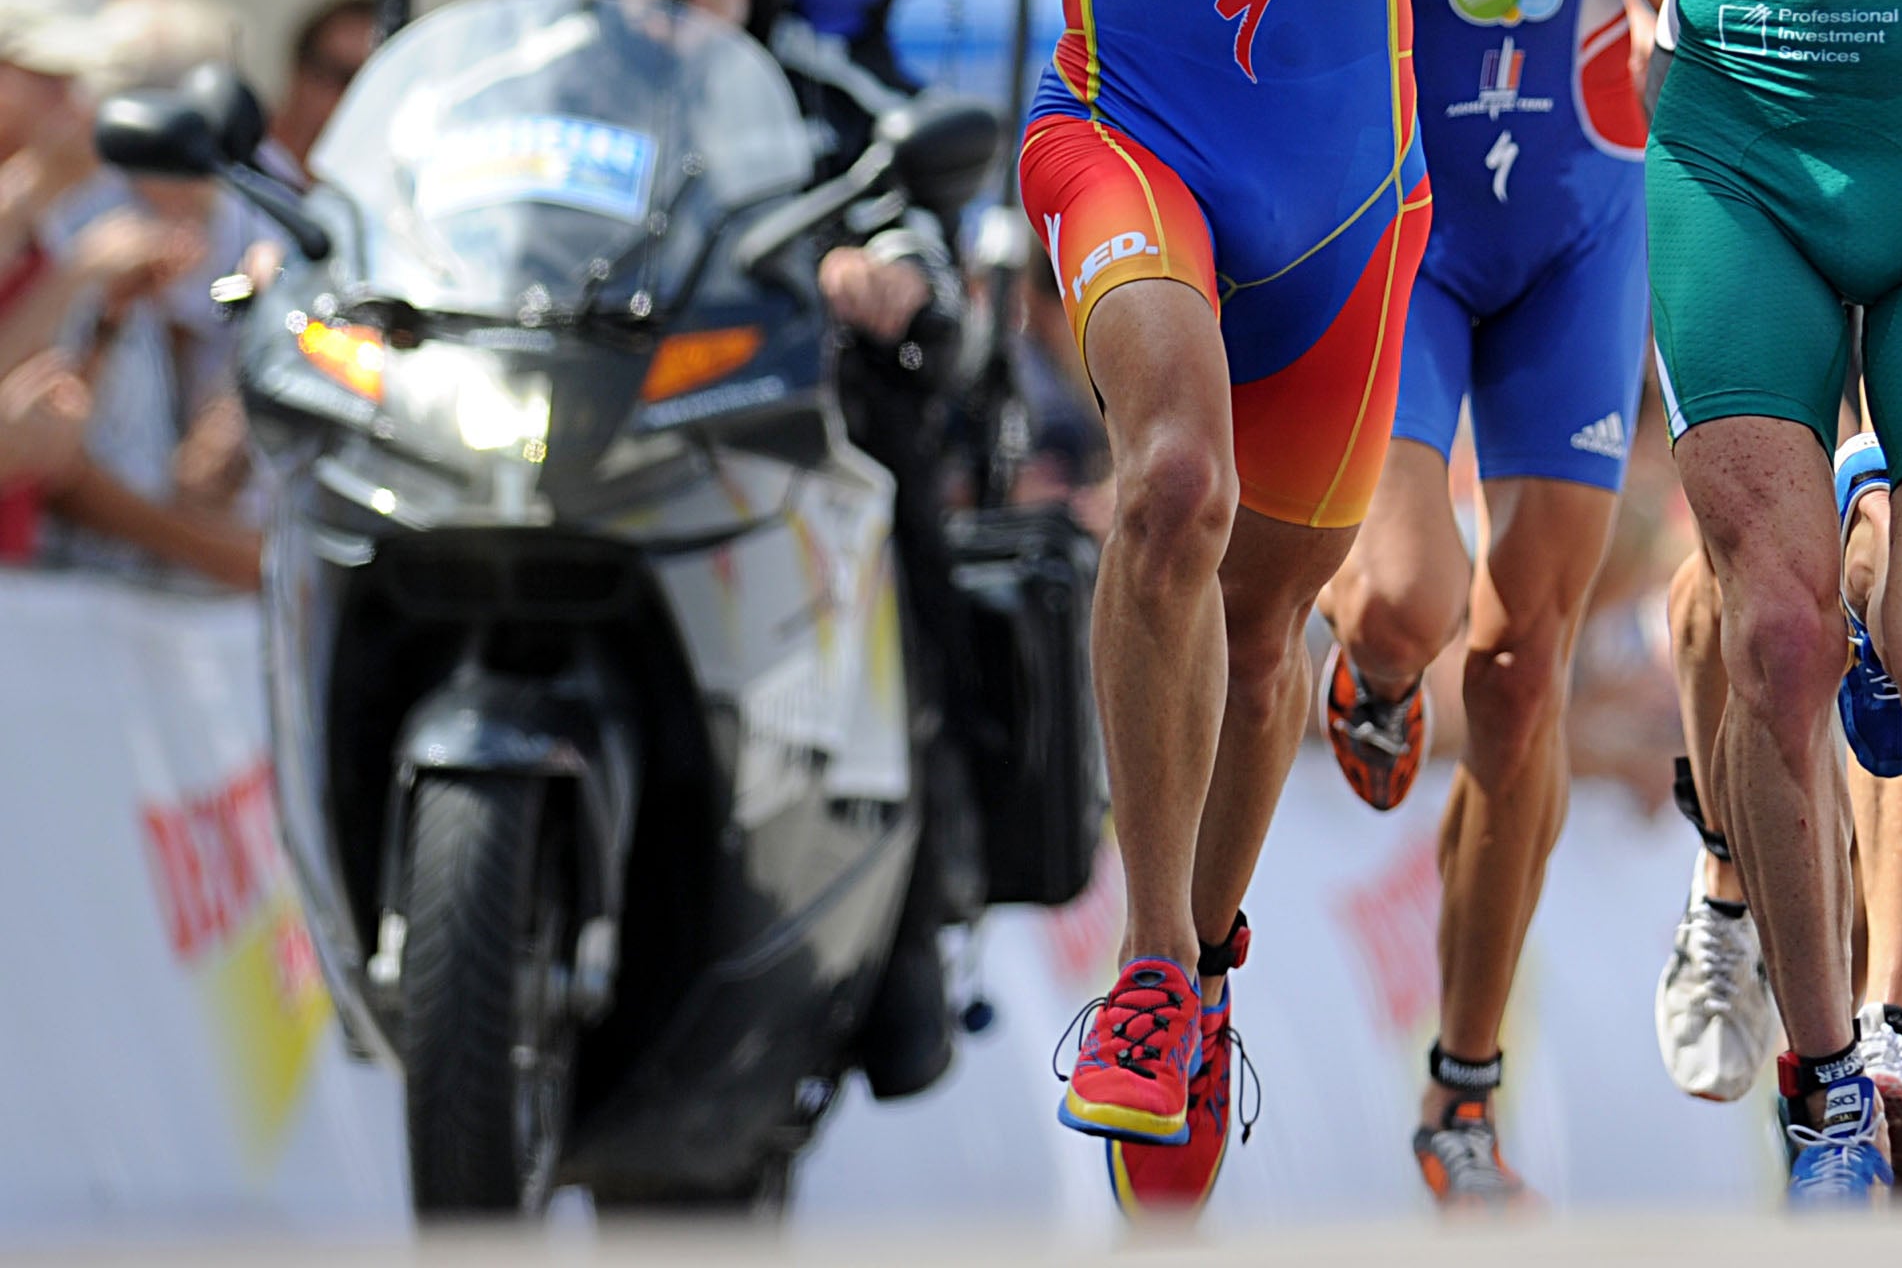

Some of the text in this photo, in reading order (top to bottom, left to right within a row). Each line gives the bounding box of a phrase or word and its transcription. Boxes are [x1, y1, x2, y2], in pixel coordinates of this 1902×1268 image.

[1778, 8, 1899, 23] Professional
[1778, 26, 1885, 44] Investment
[1778, 45, 1860, 63] Services
